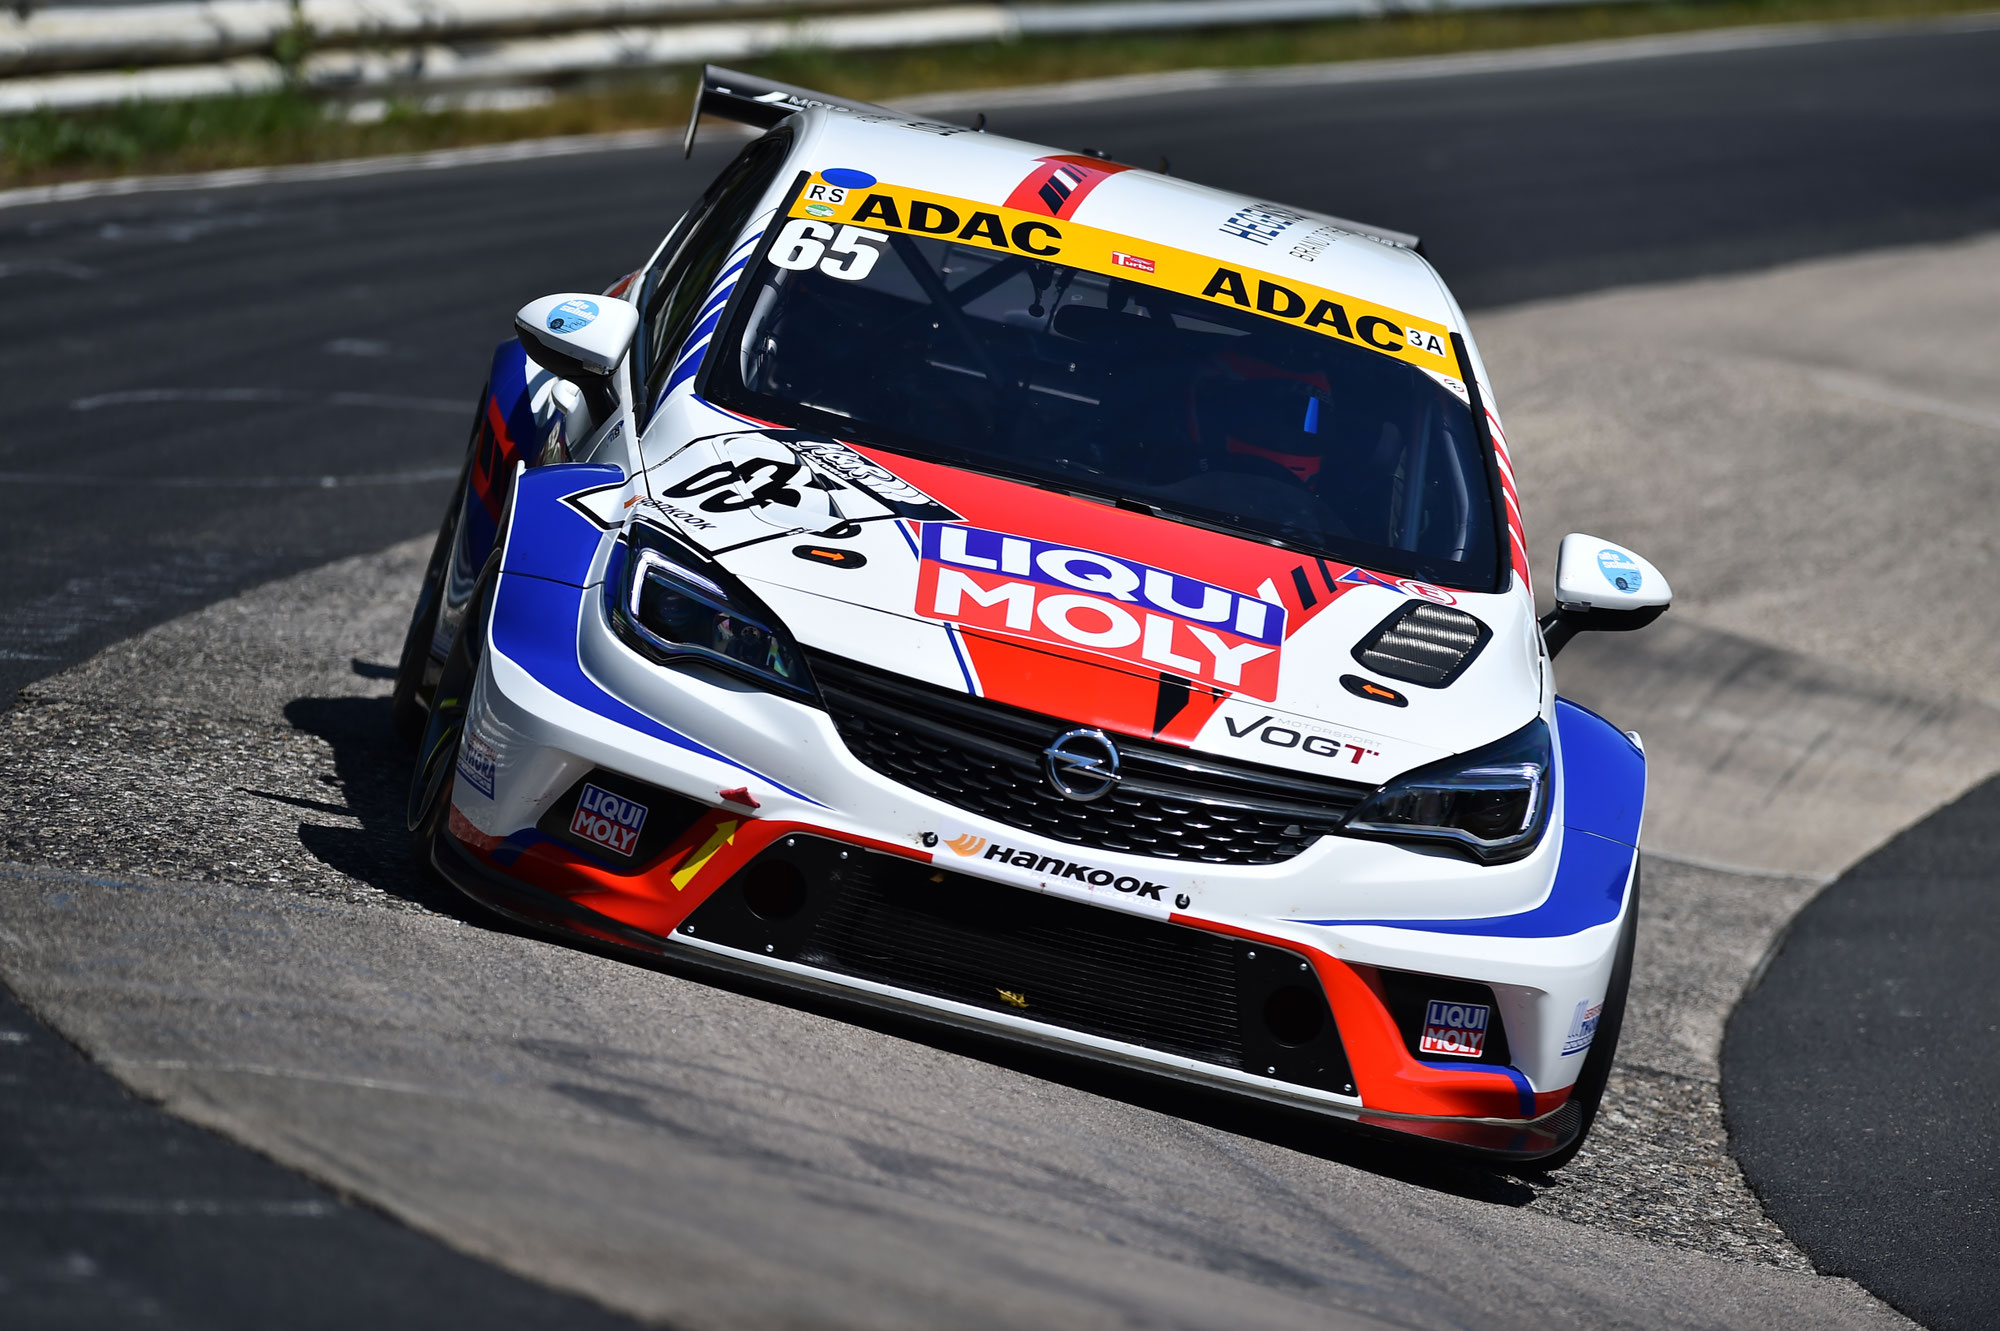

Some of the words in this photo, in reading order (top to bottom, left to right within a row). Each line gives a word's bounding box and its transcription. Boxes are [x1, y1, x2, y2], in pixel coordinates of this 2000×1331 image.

[851, 194, 1062, 257] ADAC
[767, 219, 890, 281] 65
[1113, 251, 1154, 271] Turbo
[1202, 267, 1404, 352] ADAC
[940, 526, 1267, 639] LIQUI
[934, 567, 1277, 687] MOLY
[1224, 715, 1372, 765] VOGT
[1277, 718, 1382, 749] MOTORSPORT
[582, 785, 643, 828] LIQUI
[573, 811, 637, 850] MOLY
[1430, 1003, 1485, 1031] LIQUI
[1424, 1028, 1483, 1053] MOLY
